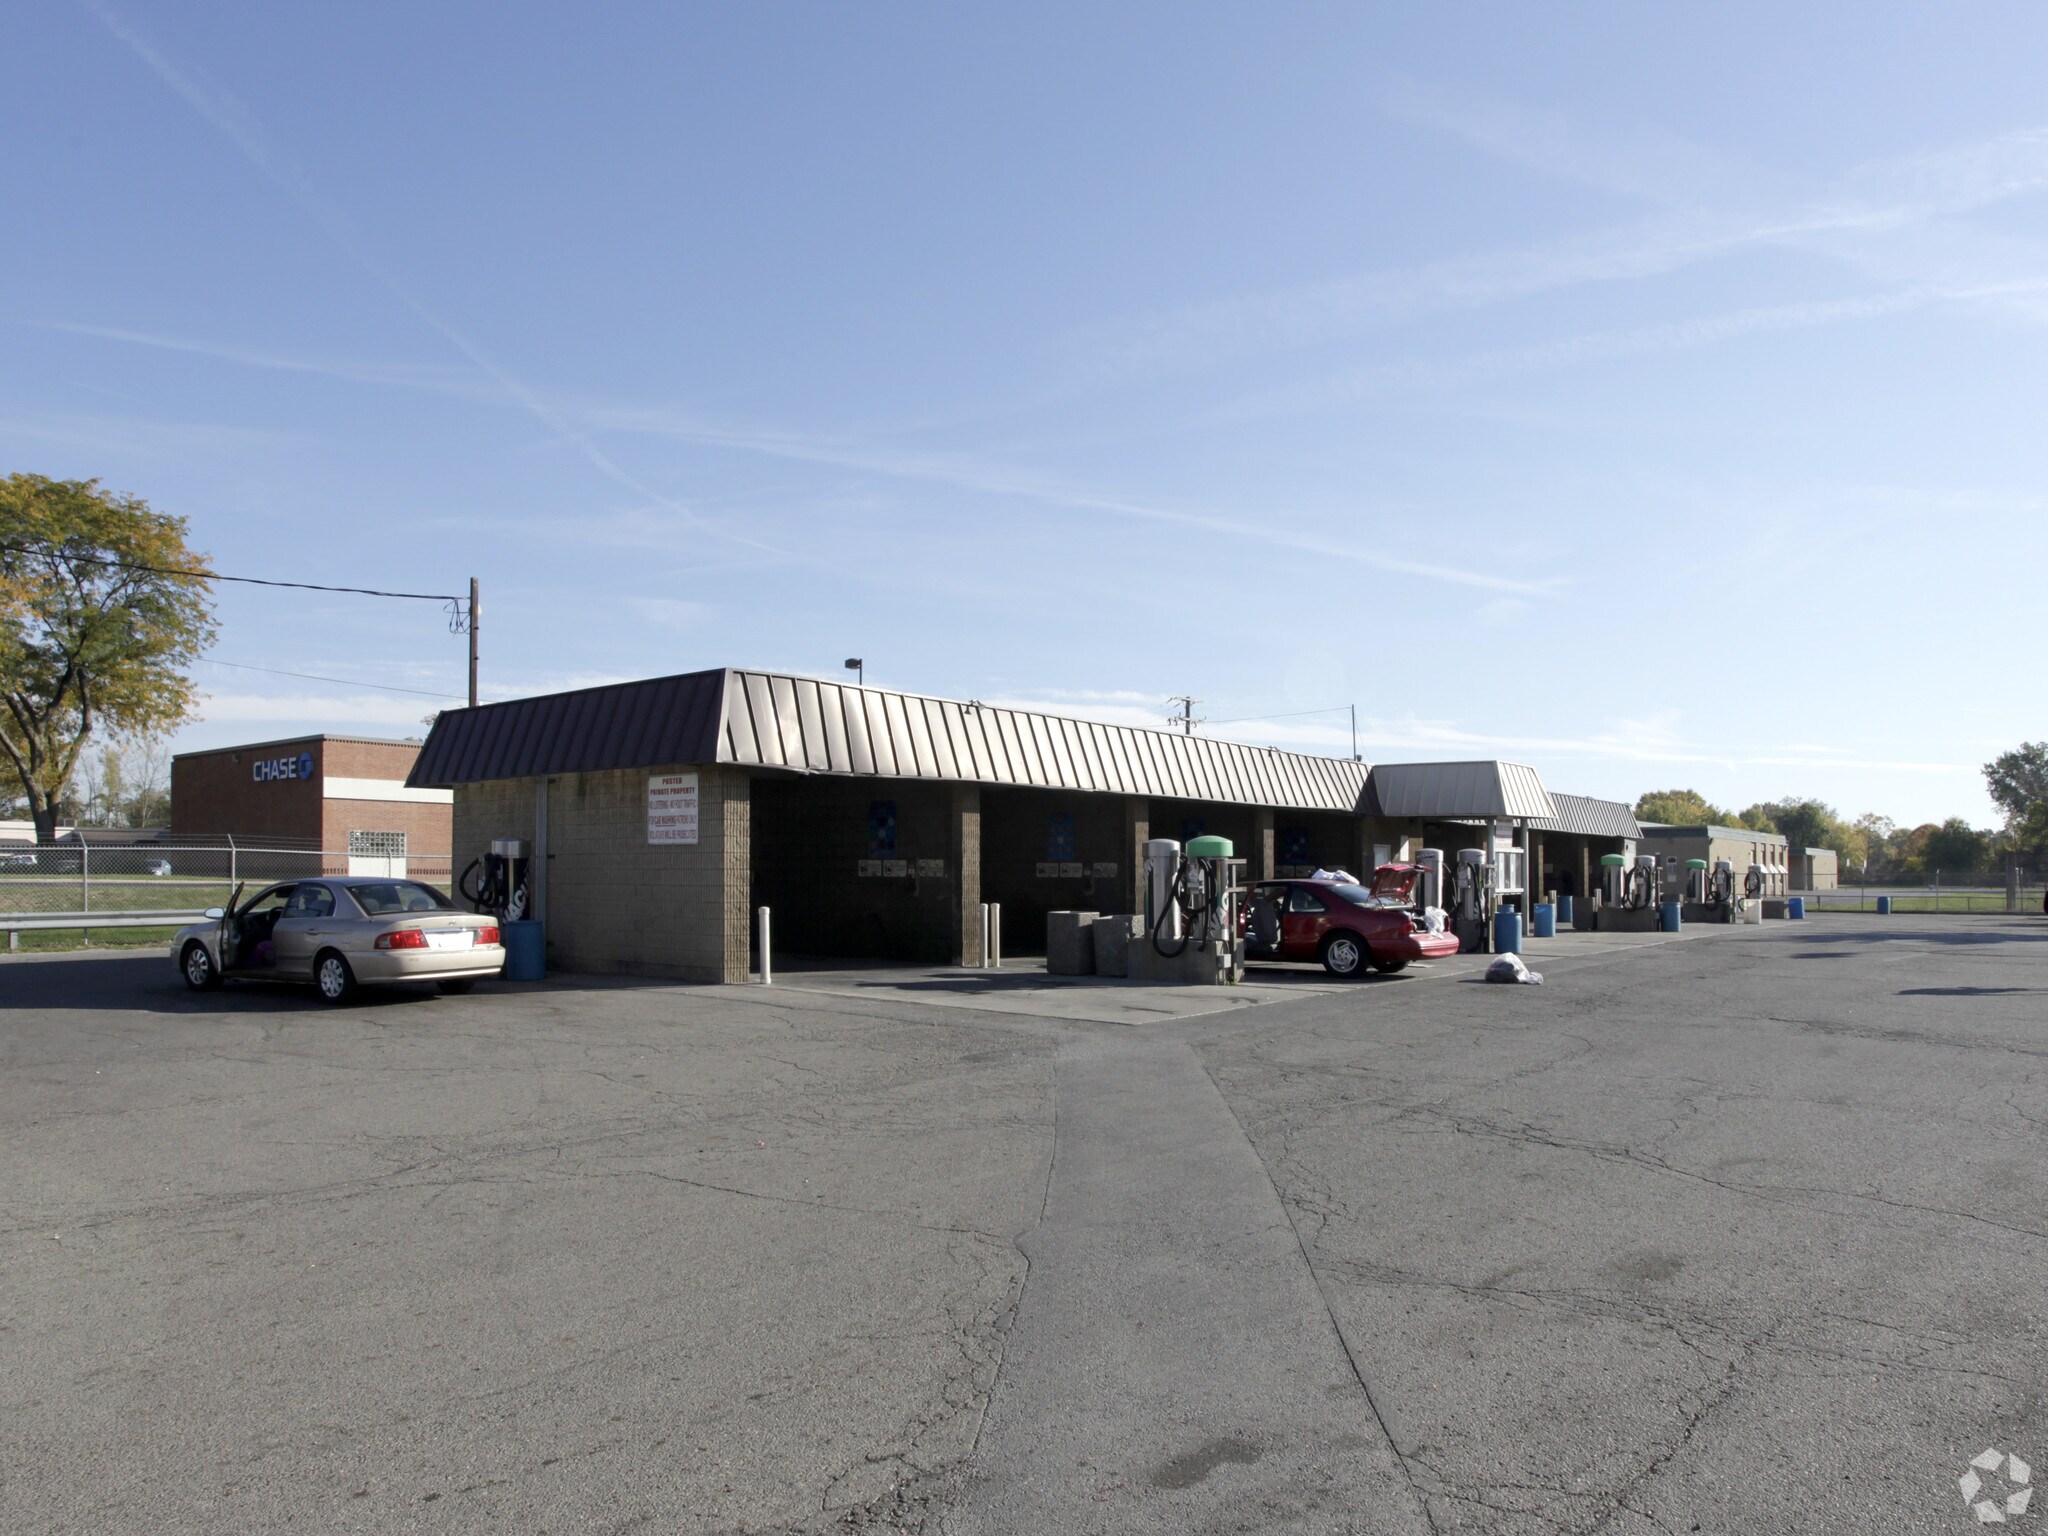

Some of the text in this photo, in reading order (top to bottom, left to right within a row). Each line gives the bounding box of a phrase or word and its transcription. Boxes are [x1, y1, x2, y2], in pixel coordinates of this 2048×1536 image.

[253, 756, 297, 782] CHASE
[662, 777, 682, 785] POSTED
[650, 787, 695, 796] PRIVATE PROPERTY
